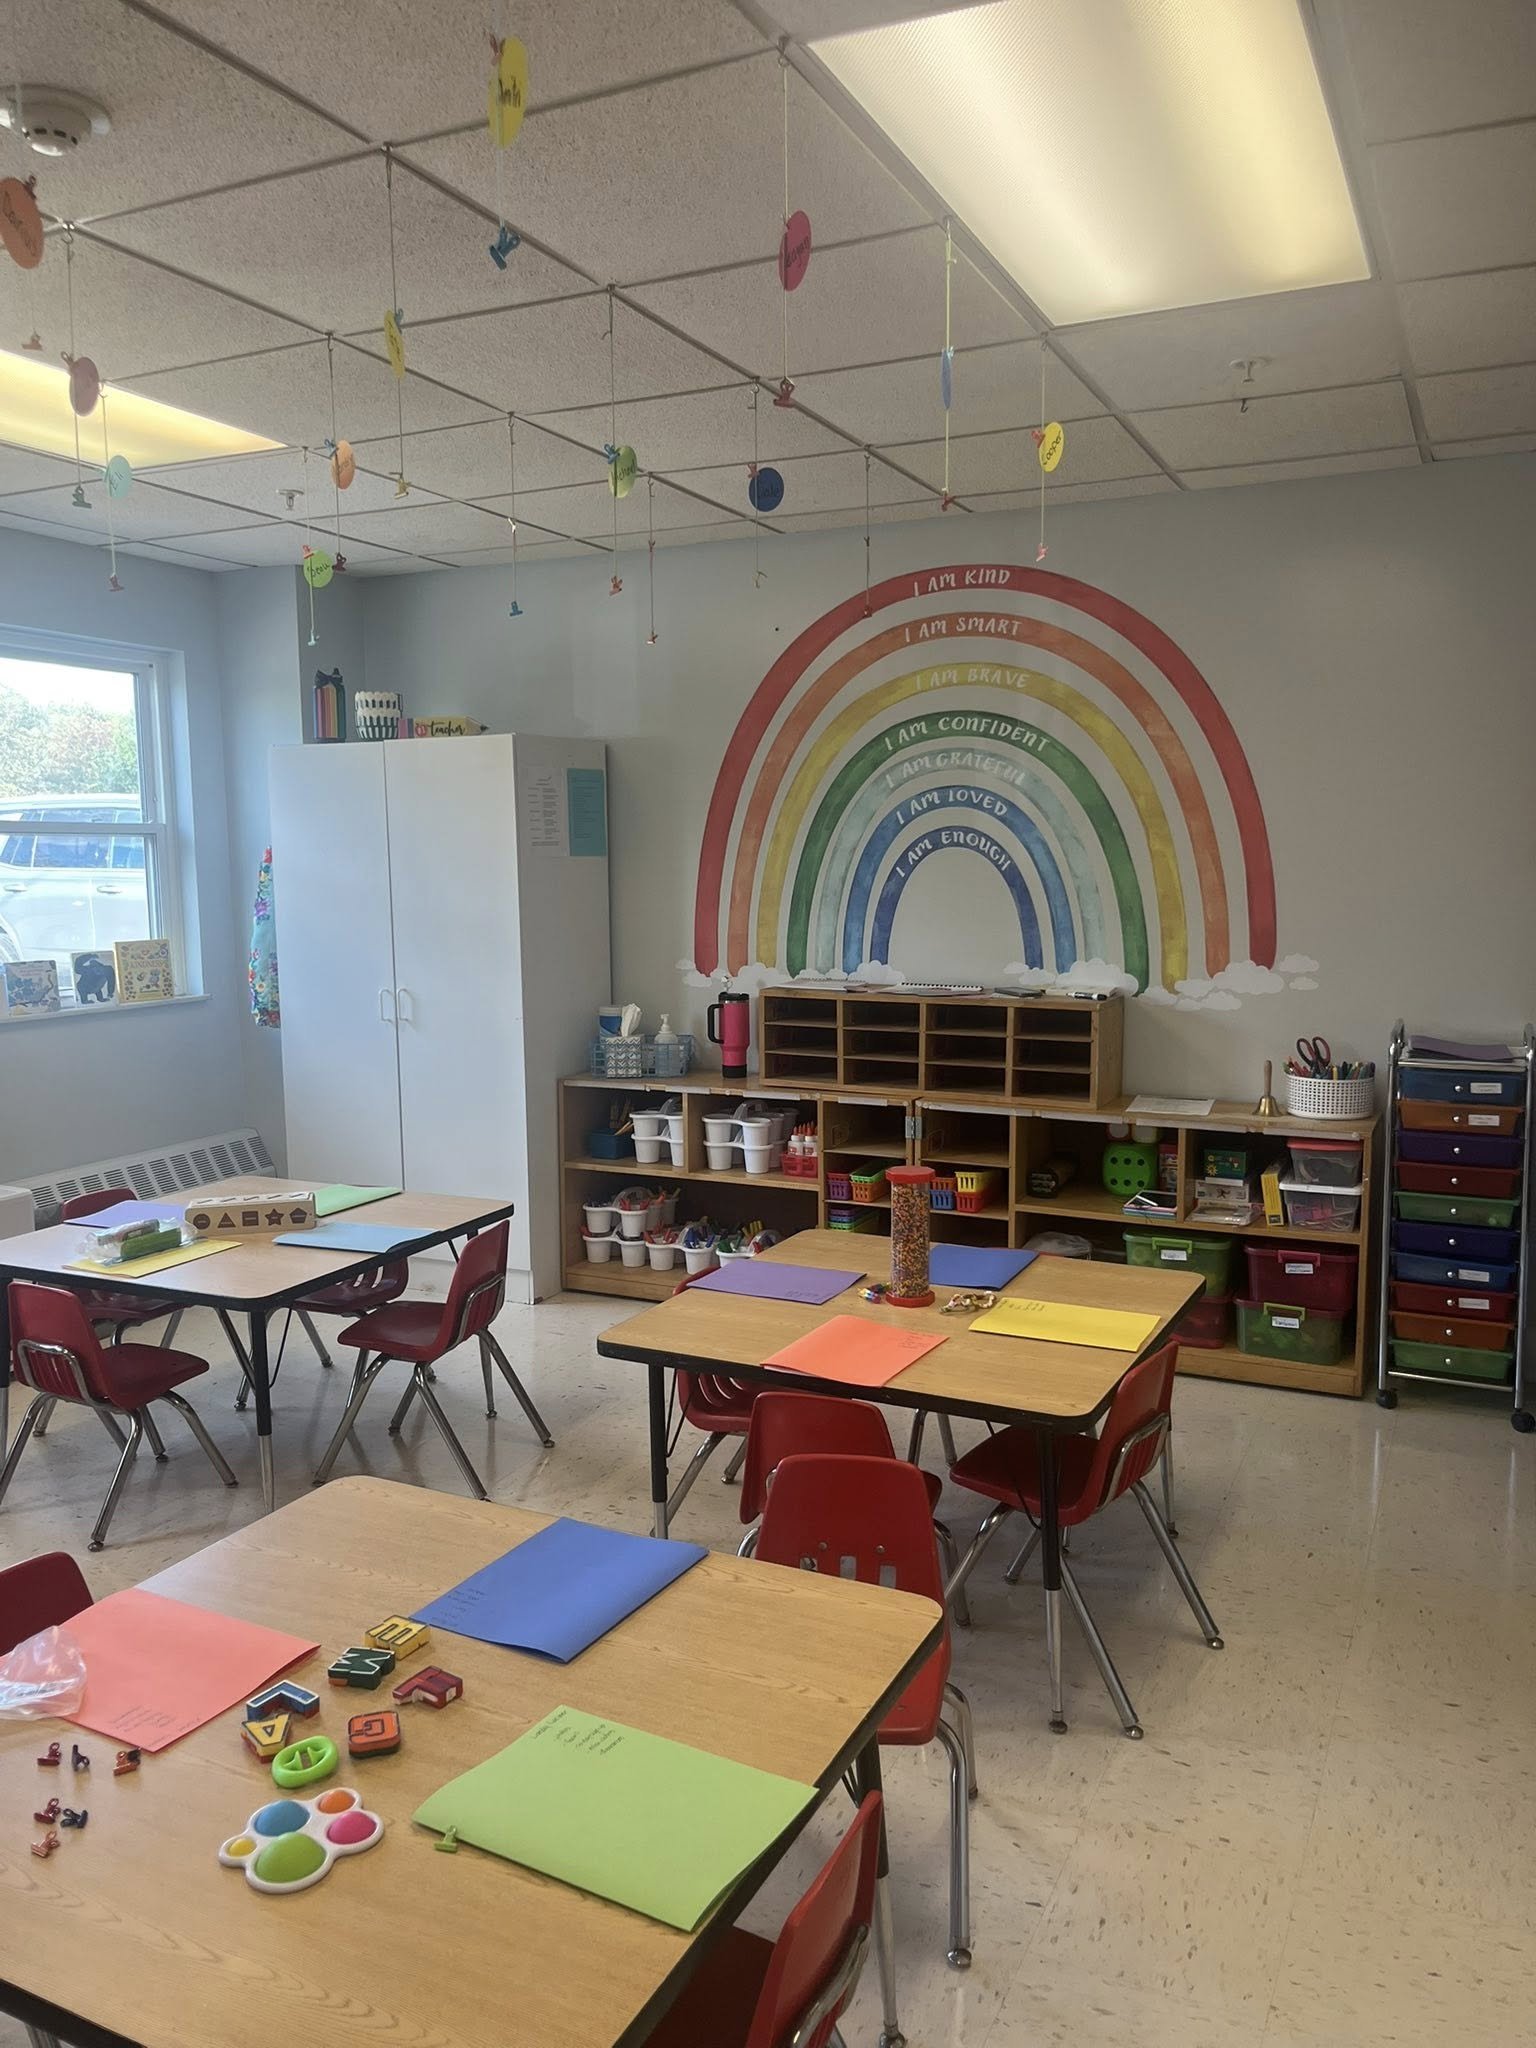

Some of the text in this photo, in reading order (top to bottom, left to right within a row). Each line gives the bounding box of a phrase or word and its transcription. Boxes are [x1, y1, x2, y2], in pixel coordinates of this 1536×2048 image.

[913, 568, 1011, 597] I AM KIND
[904, 616, 1022, 643] I AM SMART
[915, 668, 1030, 690] I AM BRAVE
[884, 716, 1051, 752] I AM CONFIDENT
[885, 752, 1027, 788] I AM GRATEFUL
[896, 789, 1009, 825] I AM LOVED
[895, 831, 1012, 878] I AM ENOUGH
